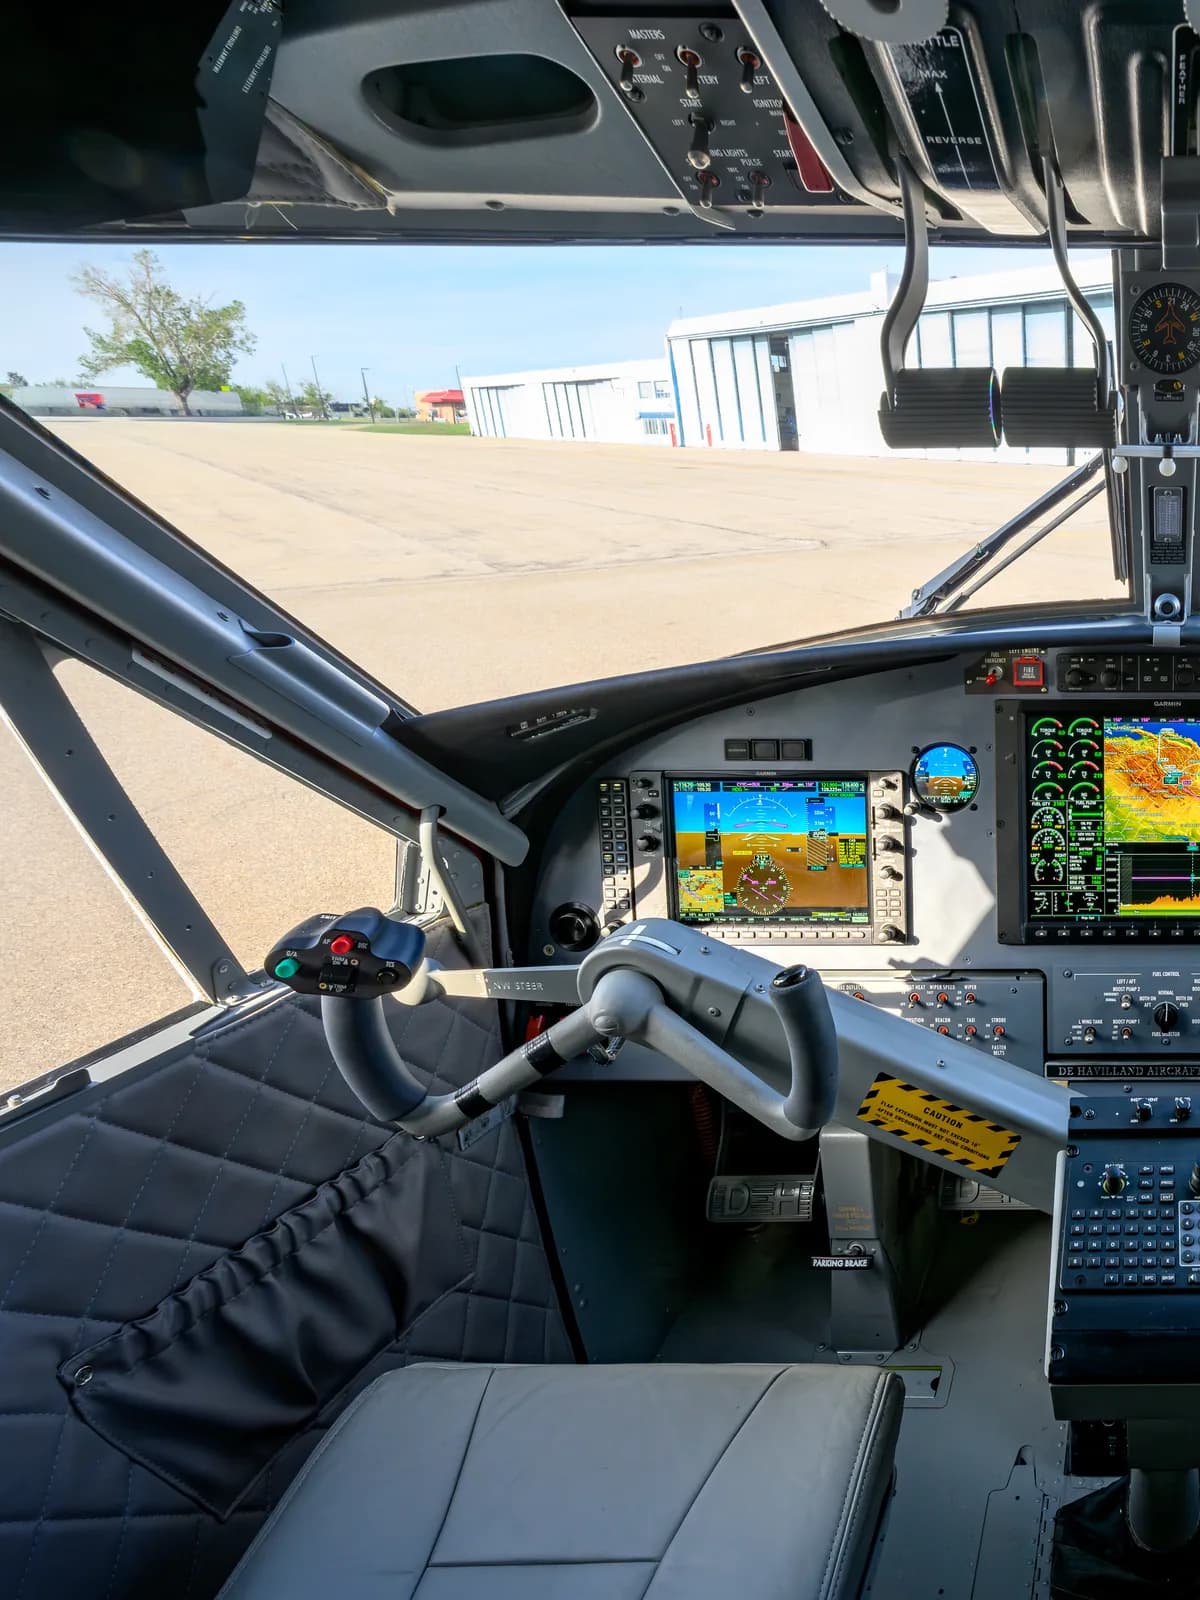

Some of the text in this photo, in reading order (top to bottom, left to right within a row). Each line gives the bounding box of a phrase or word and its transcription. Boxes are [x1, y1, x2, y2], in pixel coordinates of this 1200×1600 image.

[629, 30, 665, 40] MASTERS
[919, 71, 948, 79] MAX
[1178, 54, 1186, 104] FEATHER
[752, 75, 770, 85] LEFT
[680, 98, 702, 108] START
[926, 136, 982, 145] REVERSE
[722, 150, 748, 158] LIGHTS
[740, 159, 762, 167] PULSE
[1155, 300, 1162, 308] S
[1180, 301, 1190, 310] 24
[1144, 307, 1152, 318] 15
[1140, 323, 1148, 332] 12
[1192, 328, 1200, 336] 30
[1142, 338, 1150, 346] E
[493, 982, 544, 990] NW STEER
[1058, 1064, 1074, 1076] DE
[1077, 1064, 1144, 1076] HAVILLAND
[923, 1106, 964, 1128] CAUTION
[880, 1100, 894, 1108] FLAP
[895, 1107, 922, 1122] EXTENSION
[924, 1120, 938, 1130] MUST
[940, 1127, 949, 1135] NOT
[951, 1132, 969, 1144] EXCEED
[878, 1108, 893, 1117] AFTER
[895, 1115, 932, 1135] ENCOUNTERING
[945, 1138, 959, 1147] ICING
[960, 1144, 990, 1160] CONDITIONS
[813, 1259, 867, 1268] PARKING BRAKE
